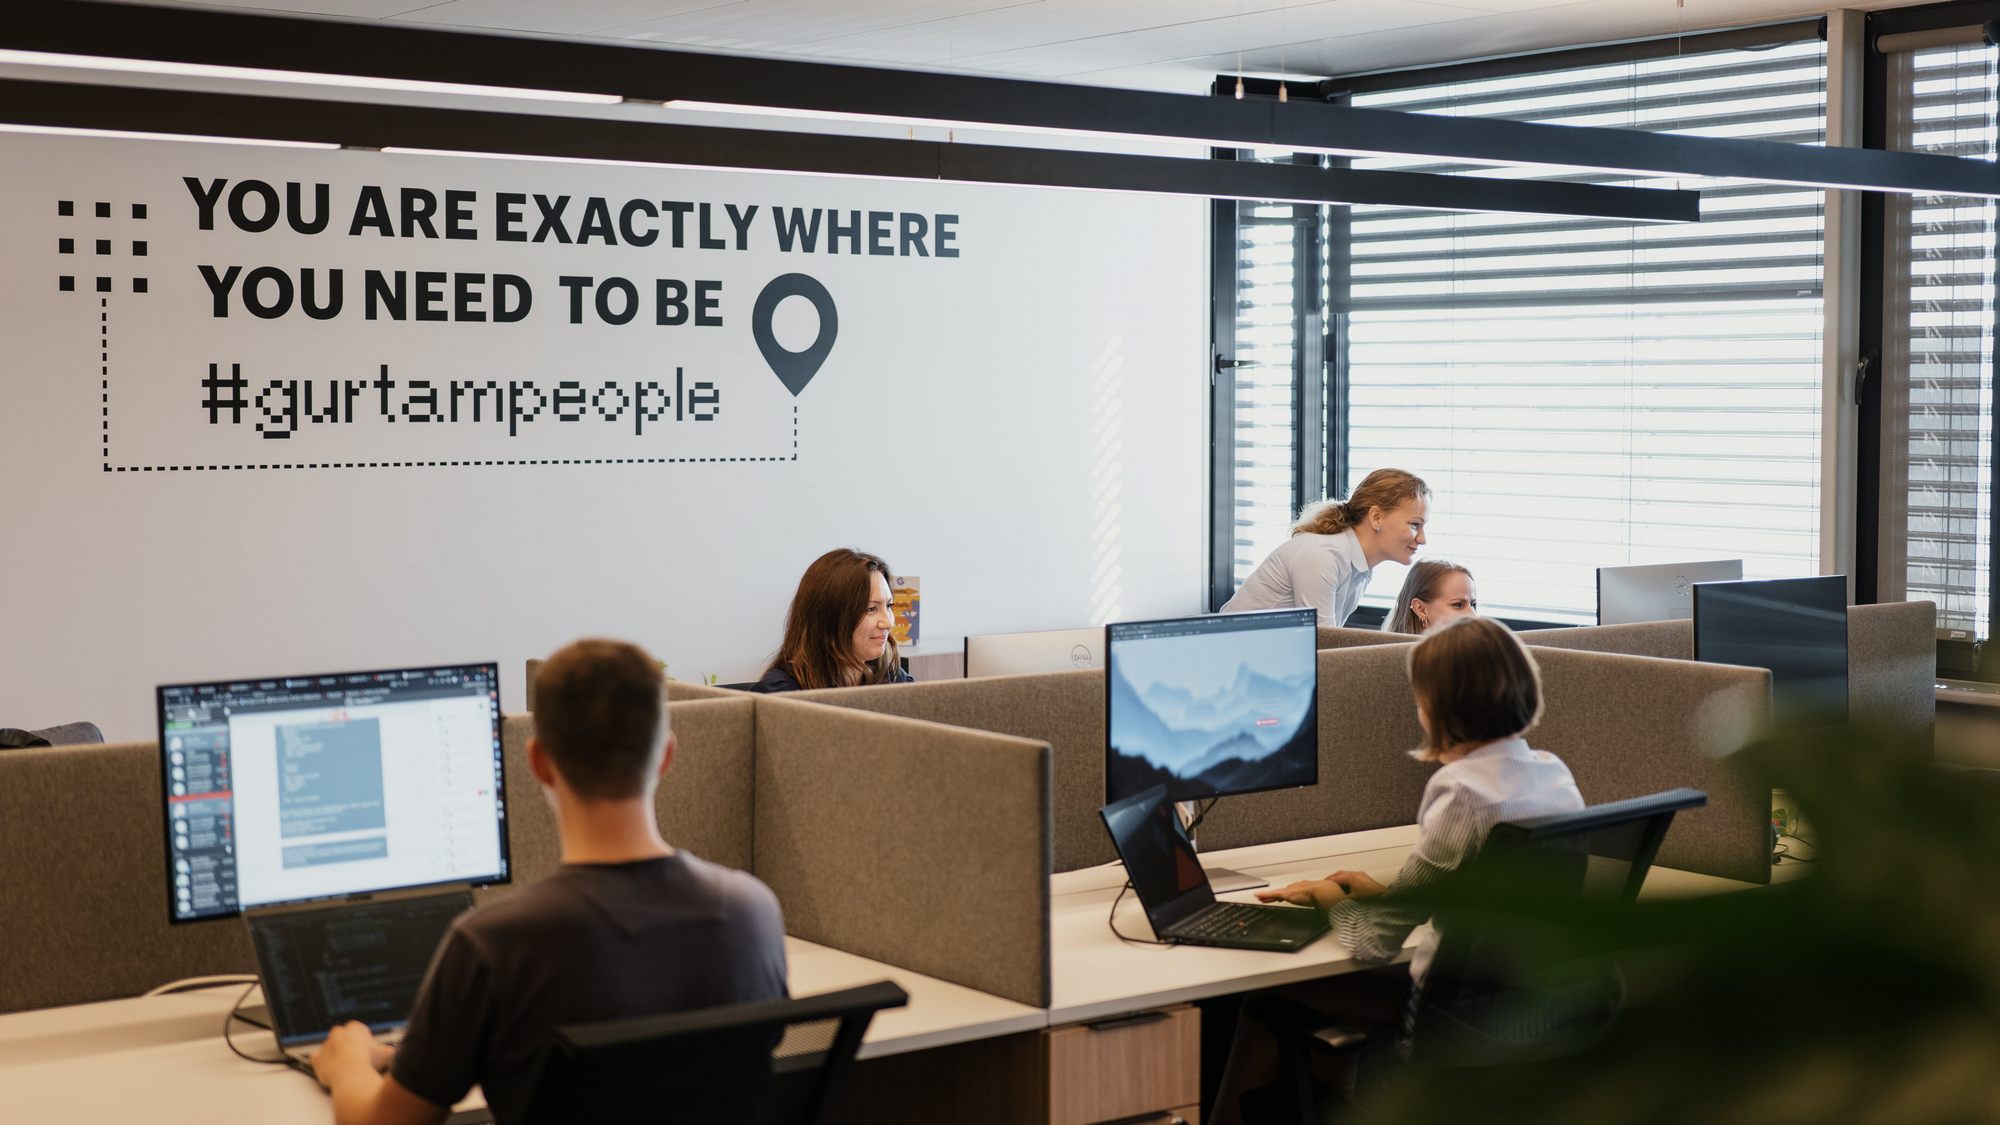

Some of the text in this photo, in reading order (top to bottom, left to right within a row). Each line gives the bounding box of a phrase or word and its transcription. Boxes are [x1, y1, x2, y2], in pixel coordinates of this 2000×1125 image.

[182, 177, 960, 258] YOU ARE EXACTLY WHERE
[198, 265, 723, 327] YOU NEED TO BE
[201, 363, 720, 440] #gurtampeople
